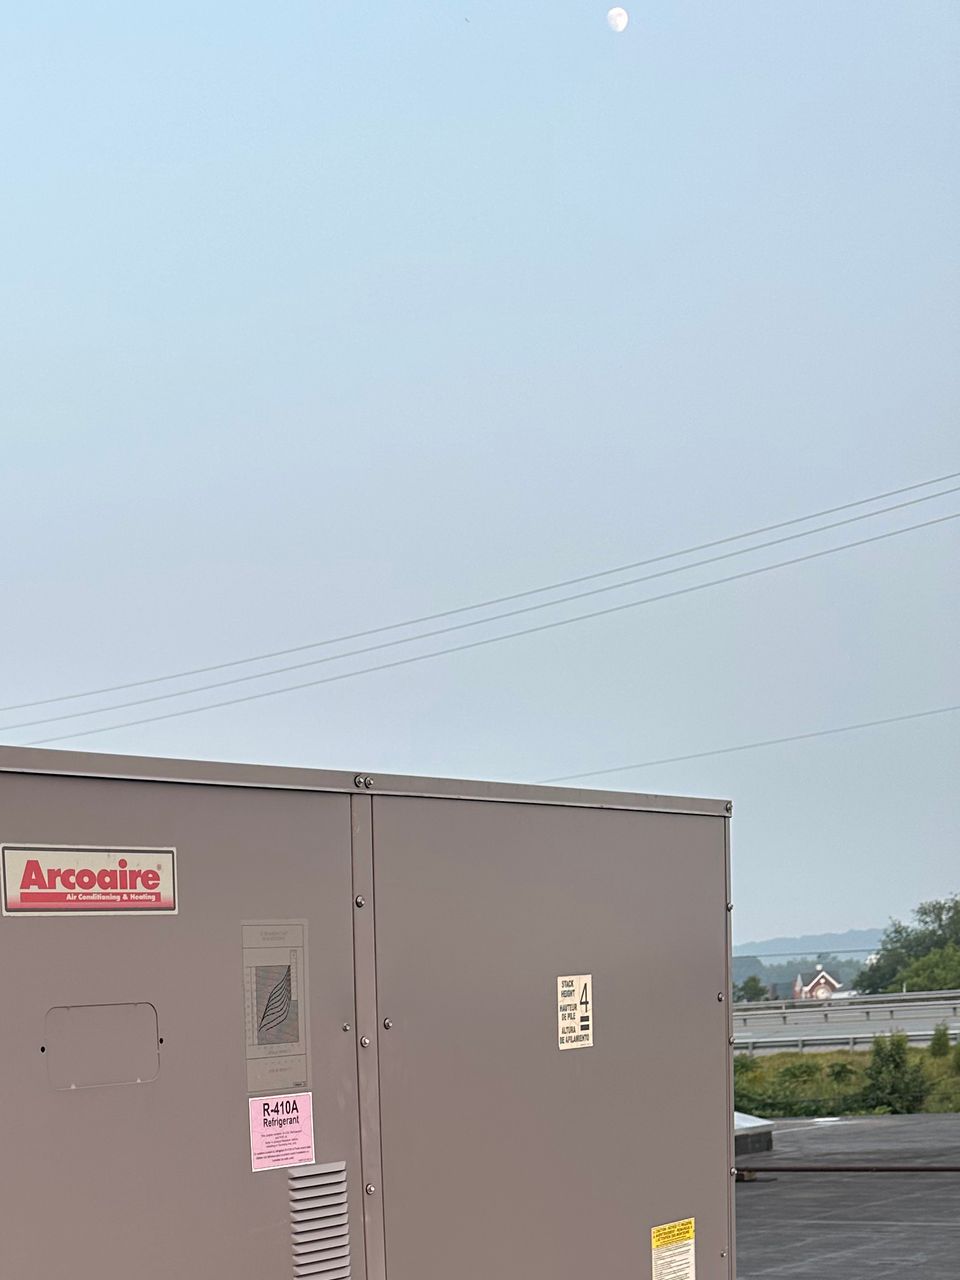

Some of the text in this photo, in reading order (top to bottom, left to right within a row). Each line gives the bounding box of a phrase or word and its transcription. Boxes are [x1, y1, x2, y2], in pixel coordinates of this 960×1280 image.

[20, 858, 160, 890] Arcoaire
[78, 893, 120, 902] Conditioning
[130, 893, 156, 902] Heating
[562, 980, 574, 988] STACK
[580, 982, 589, 1013] 4
[263, 1100, 299, 1117] R-410A
[263, 1116, 300, 1128] Refrigerant
